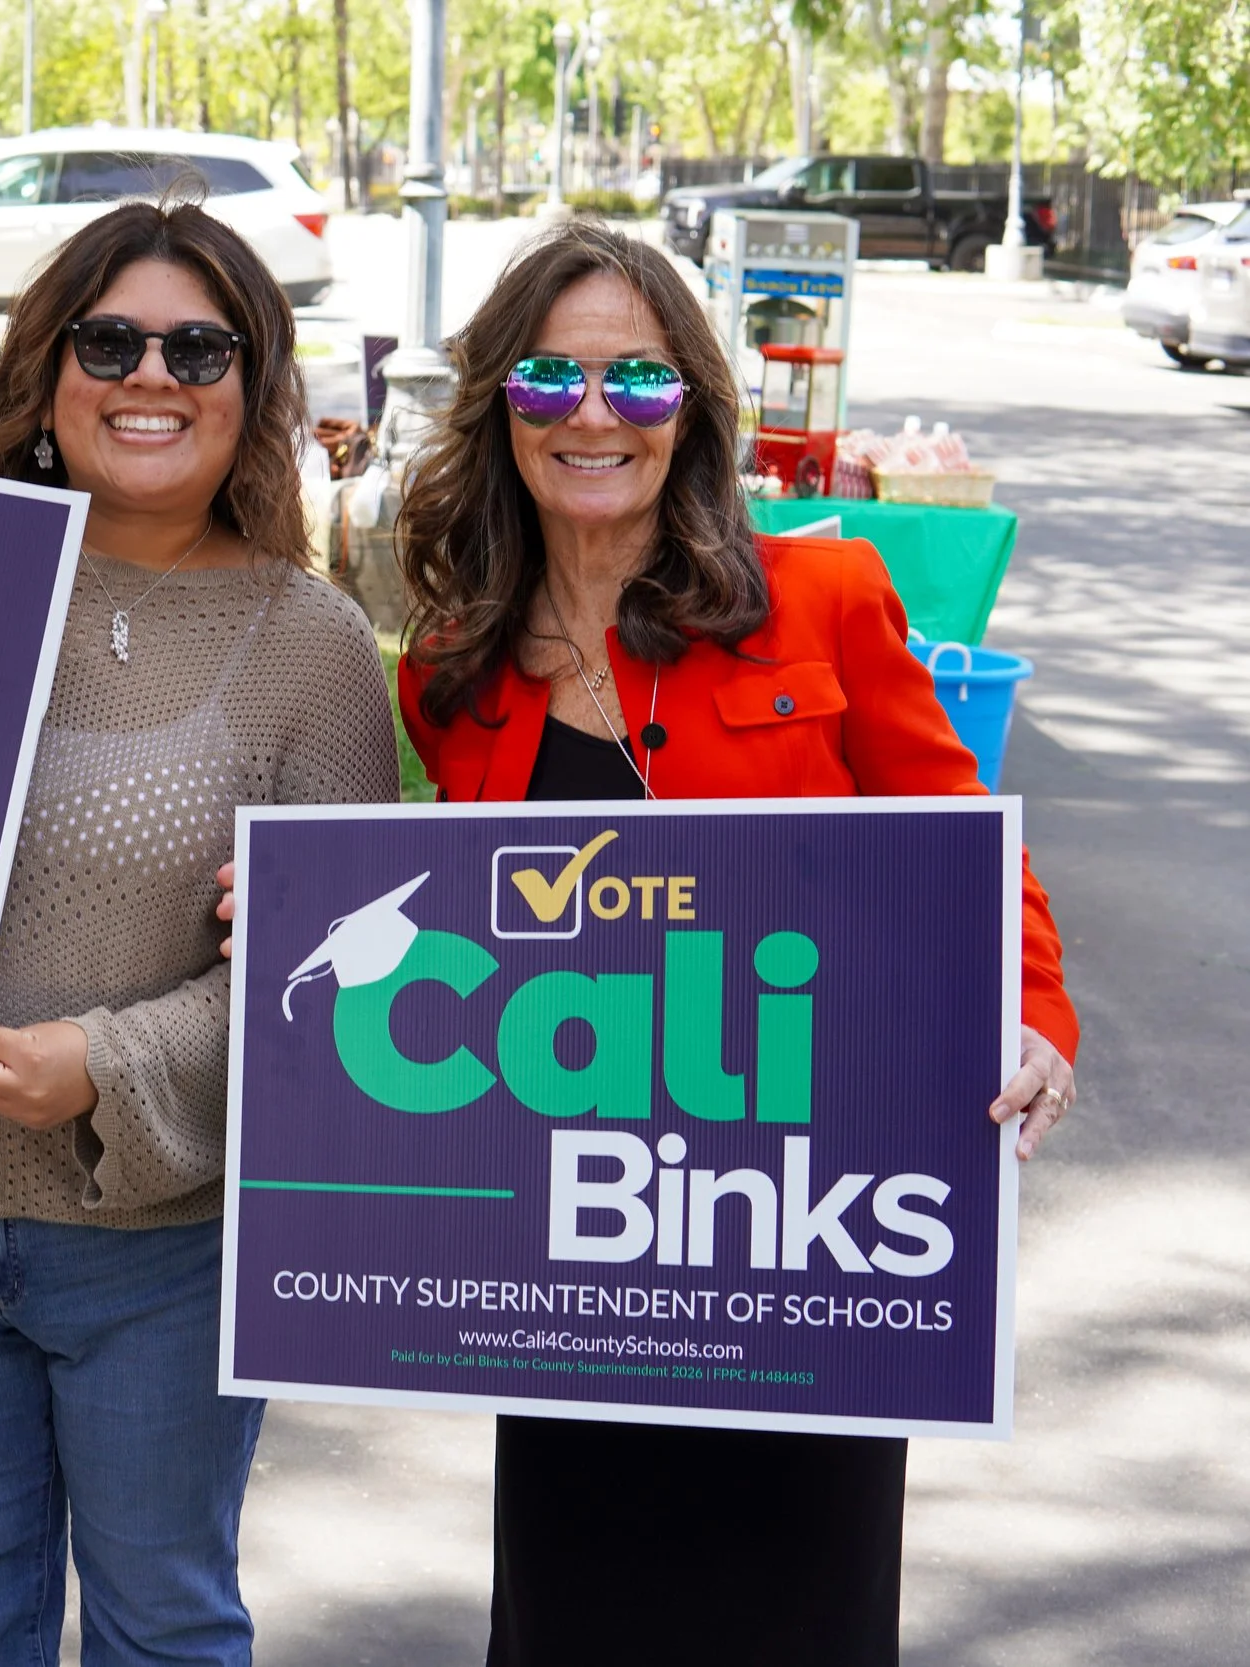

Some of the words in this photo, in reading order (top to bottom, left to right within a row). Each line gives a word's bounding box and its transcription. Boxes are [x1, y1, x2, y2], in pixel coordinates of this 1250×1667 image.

[332, 928, 821, 1125] Cali
[548, 1129, 955, 1278] Binks
[273, 1270, 411, 1305] COUNTY
[416, 1277, 719, 1322] SUPERINTENDENT
[726, 1292, 775, 1323] OF
[783, 1294, 954, 1332] SCHOOLS
[391, 1349, 415, 1363] Paid
[418, 1351, 434, 1365] for
[437, 1353, 451, 1367] by
[453, 1353, 475, 1367] Cali
[478, 1355, 509, 1369] Binks
[512, 1357, 529, 1370] for
[532, 1358, 575, 1374] County
[577, 1360, 669, 1379] Superintendent
[671, 1366, 704, 1380] 2026
[713, 1368, 747, 1382] FPPC
[750, 1370, 815, 1385] #1484453
[458, 1329, 744, 1360] www.Cali4CountySchools.com
